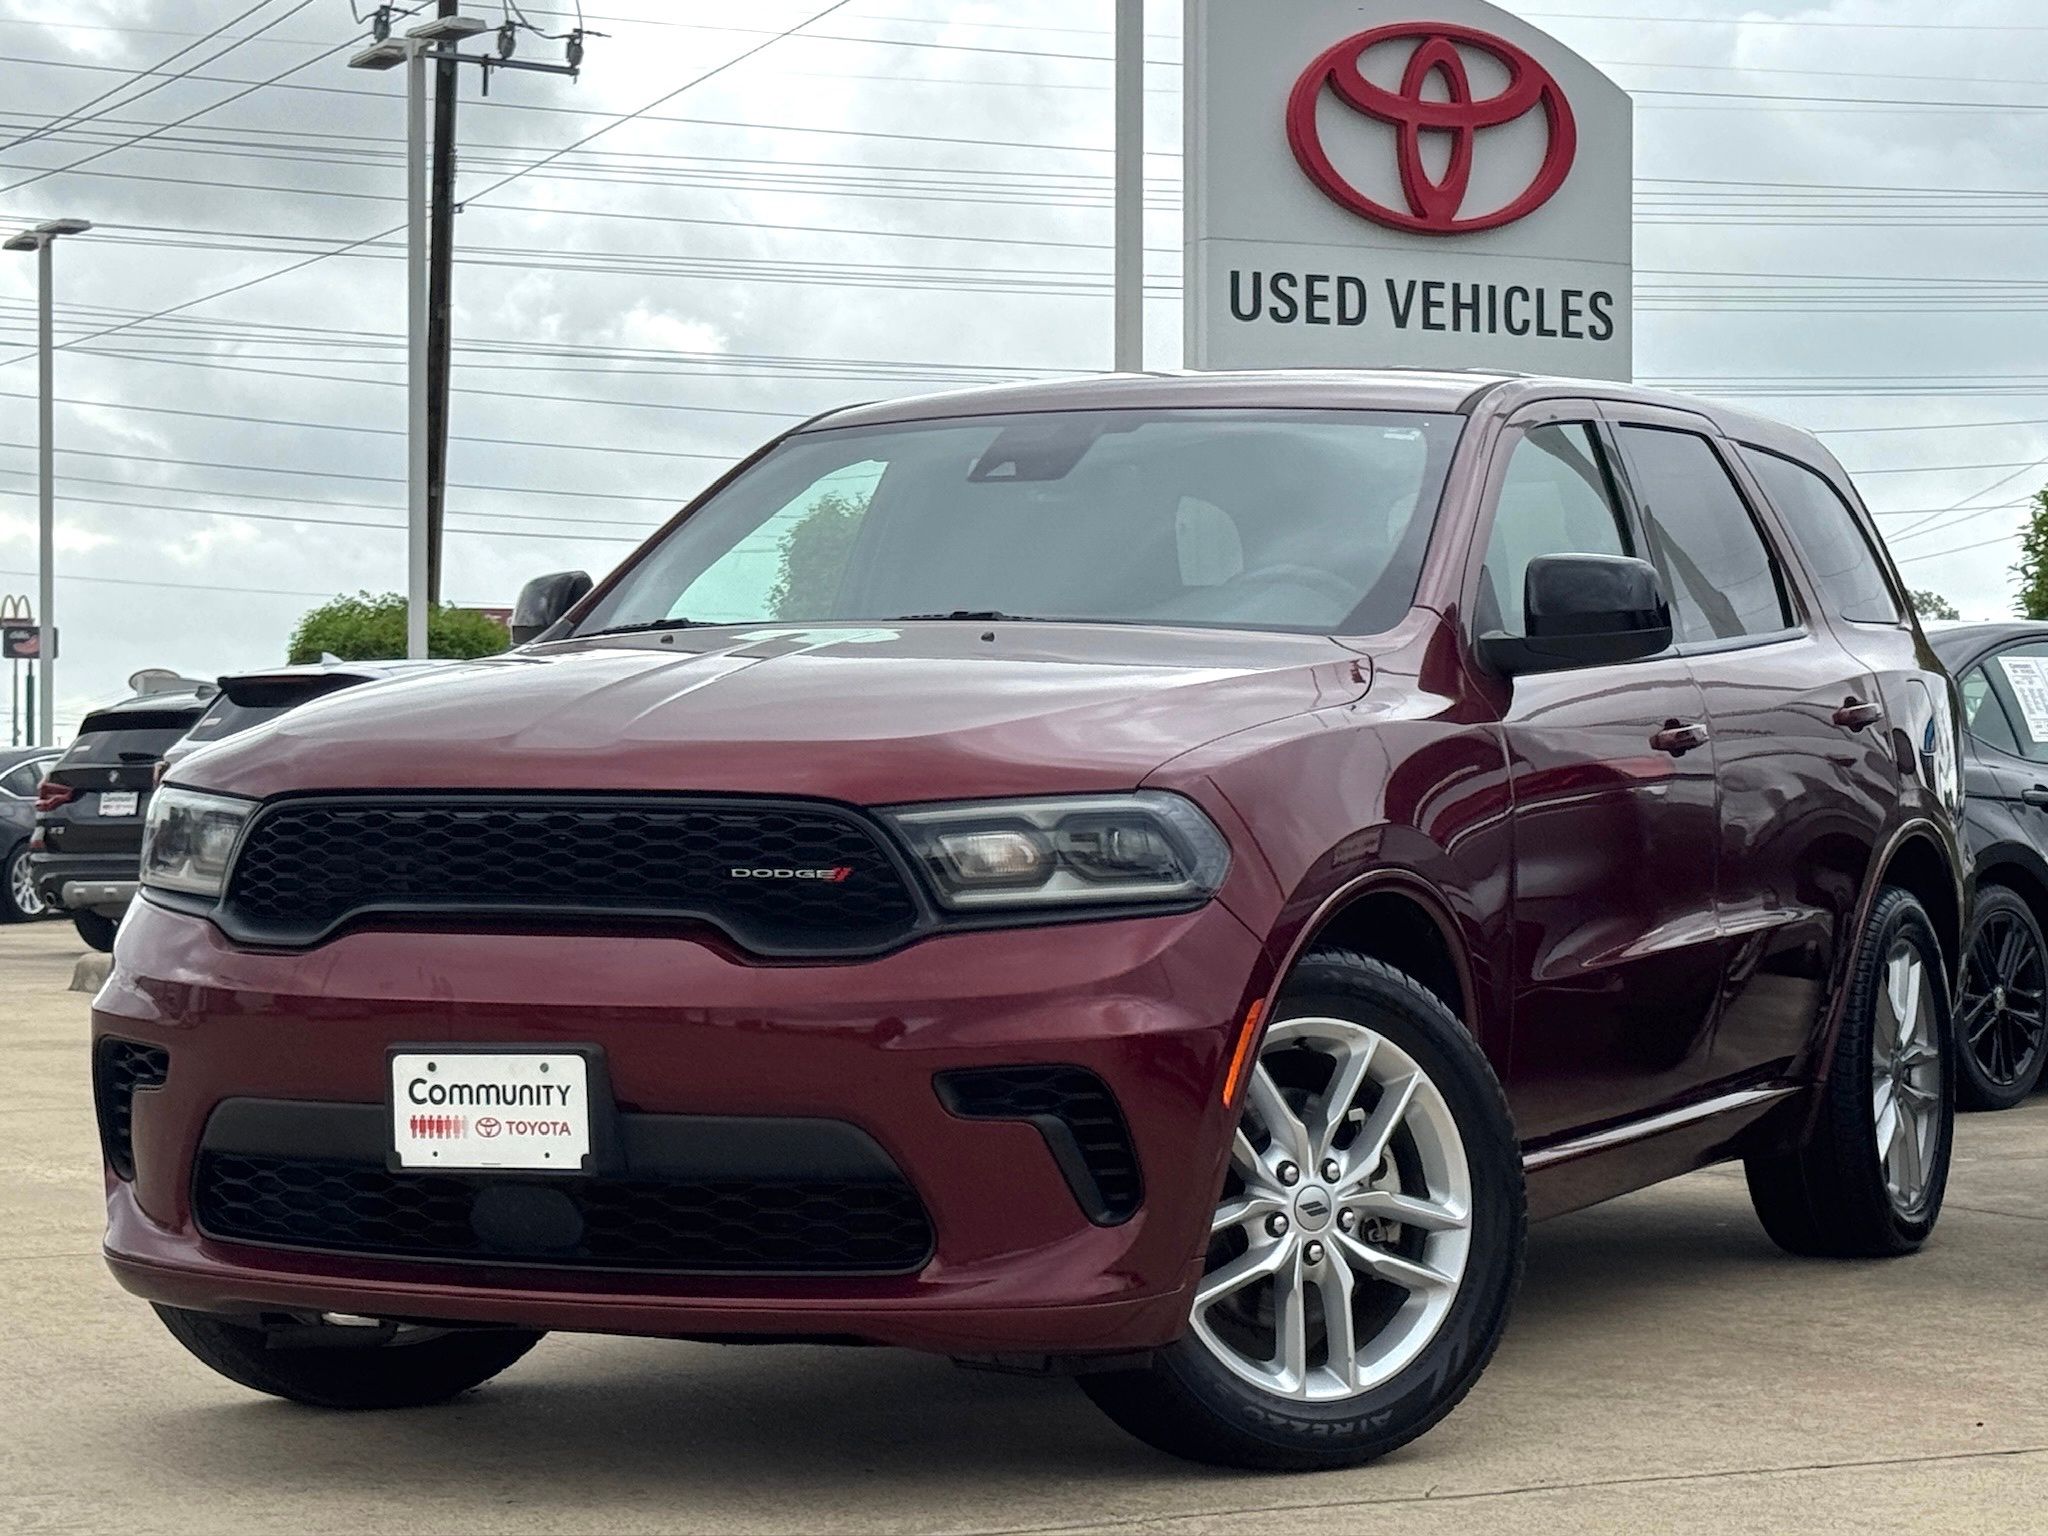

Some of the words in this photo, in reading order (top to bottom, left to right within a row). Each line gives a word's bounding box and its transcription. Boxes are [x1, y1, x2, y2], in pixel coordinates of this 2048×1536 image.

[1230, 269, 1367, 326] USED
[1385, 278, 1614, 341] VEHICLES
[731, 868, 836, 879] DODGE
[506, 1121, 571, 1136] TOYOTA
